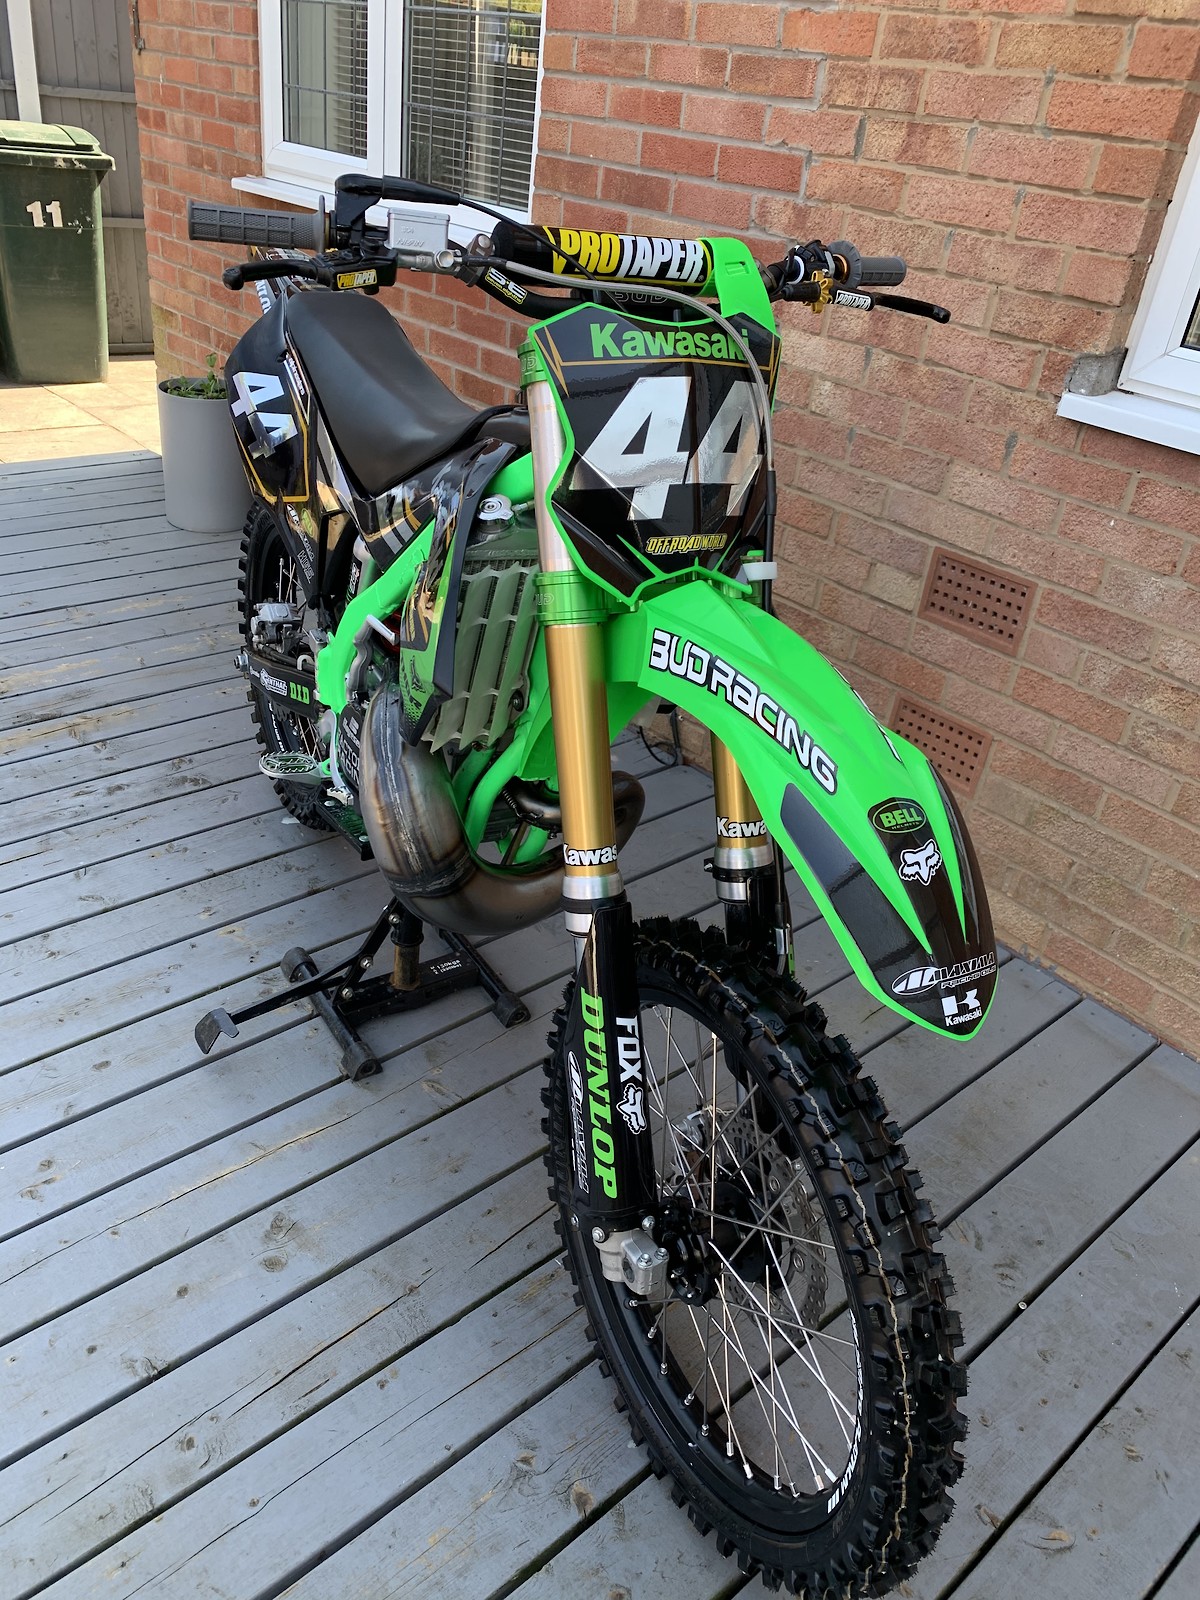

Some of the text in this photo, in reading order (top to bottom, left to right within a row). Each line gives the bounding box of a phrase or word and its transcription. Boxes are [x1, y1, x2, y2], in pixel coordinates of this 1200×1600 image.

[26, 201, 63, 227] 11
[552, 228, 704, 283] PROTAPER
[590, 323, 750, 360] Kawasaki
[569, 376, 768, 521] 44
[650, 629, 710, 686] BUD
[880, 807, 923, 828] BELL
[945, 1006, 983, 1027] Kawasaki
[616, 1016, 643, 1084] FOX
[581, 986, 618, 1199] DUNLOP
